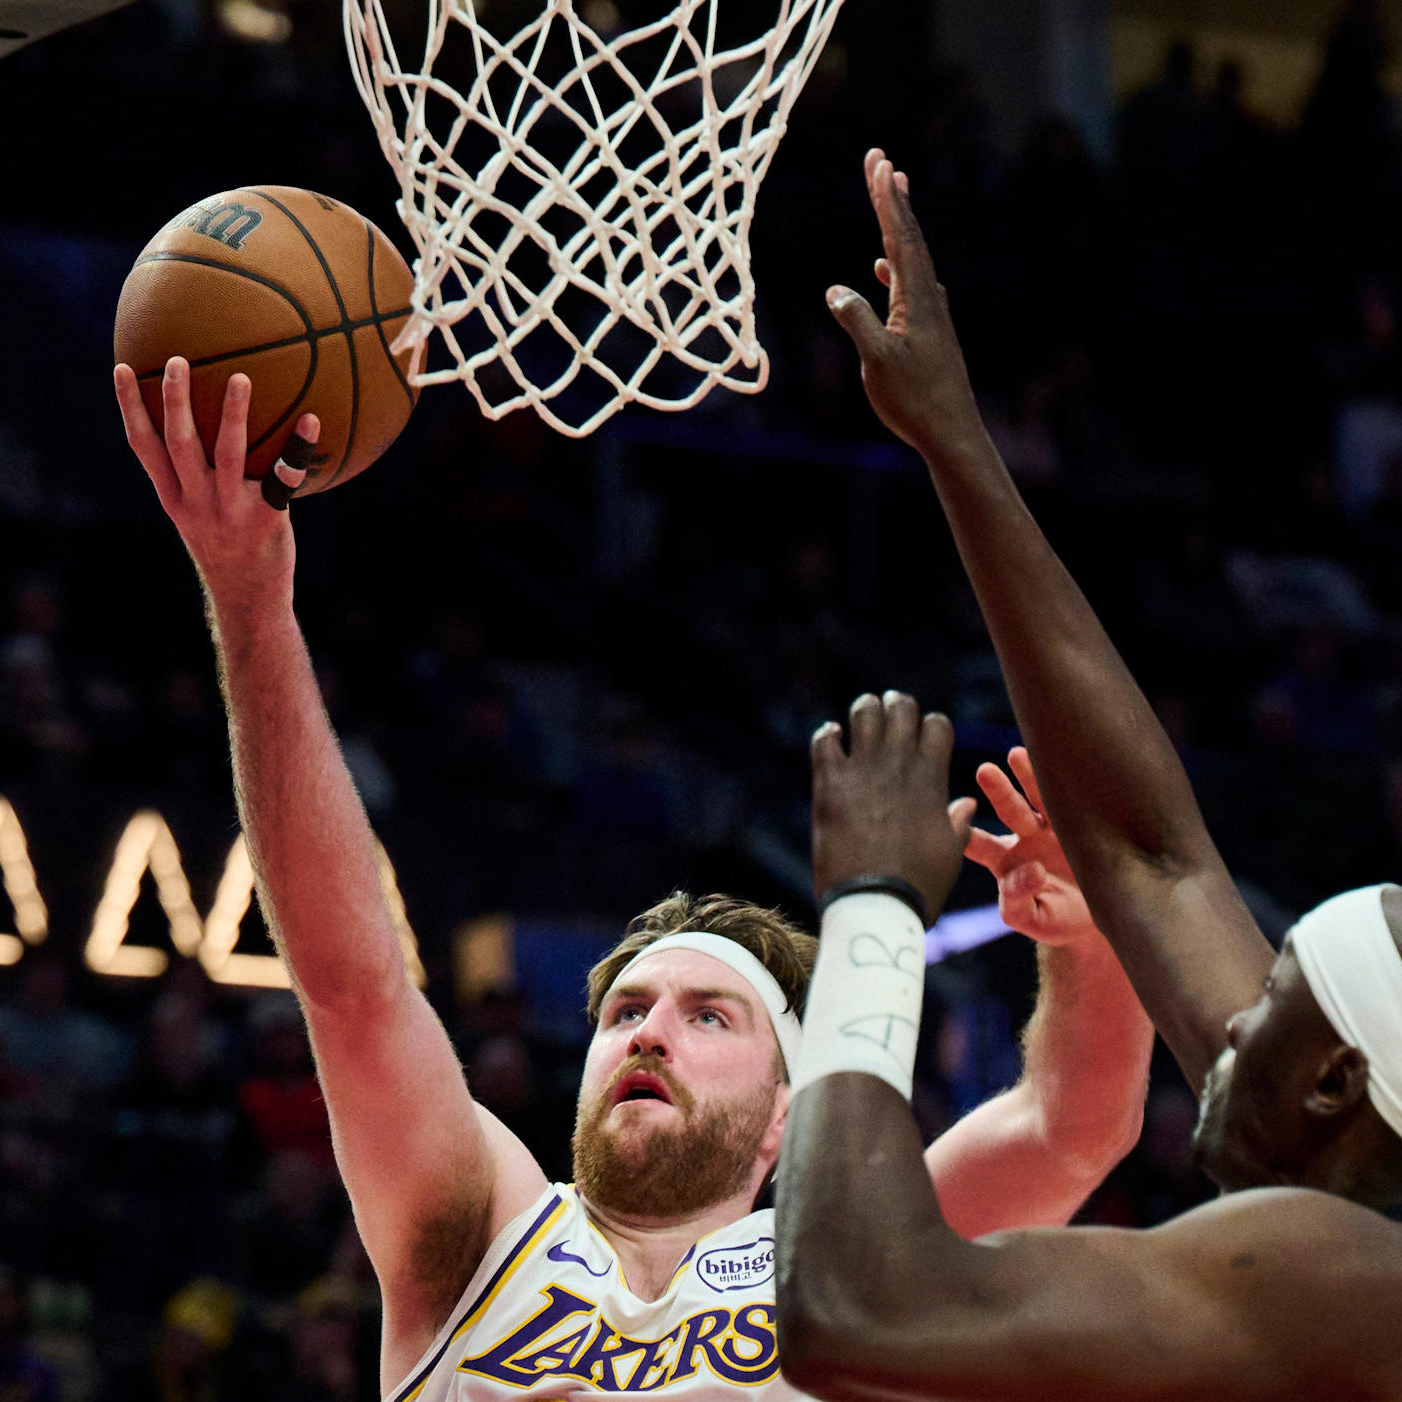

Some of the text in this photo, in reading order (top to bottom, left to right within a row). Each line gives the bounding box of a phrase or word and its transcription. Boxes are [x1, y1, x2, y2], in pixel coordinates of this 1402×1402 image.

[705, 1249, 775, 1274] bibigo
[719, 1270, 752, 1283] 비비고
[456, 1282, 781, 1392] LAKERS
